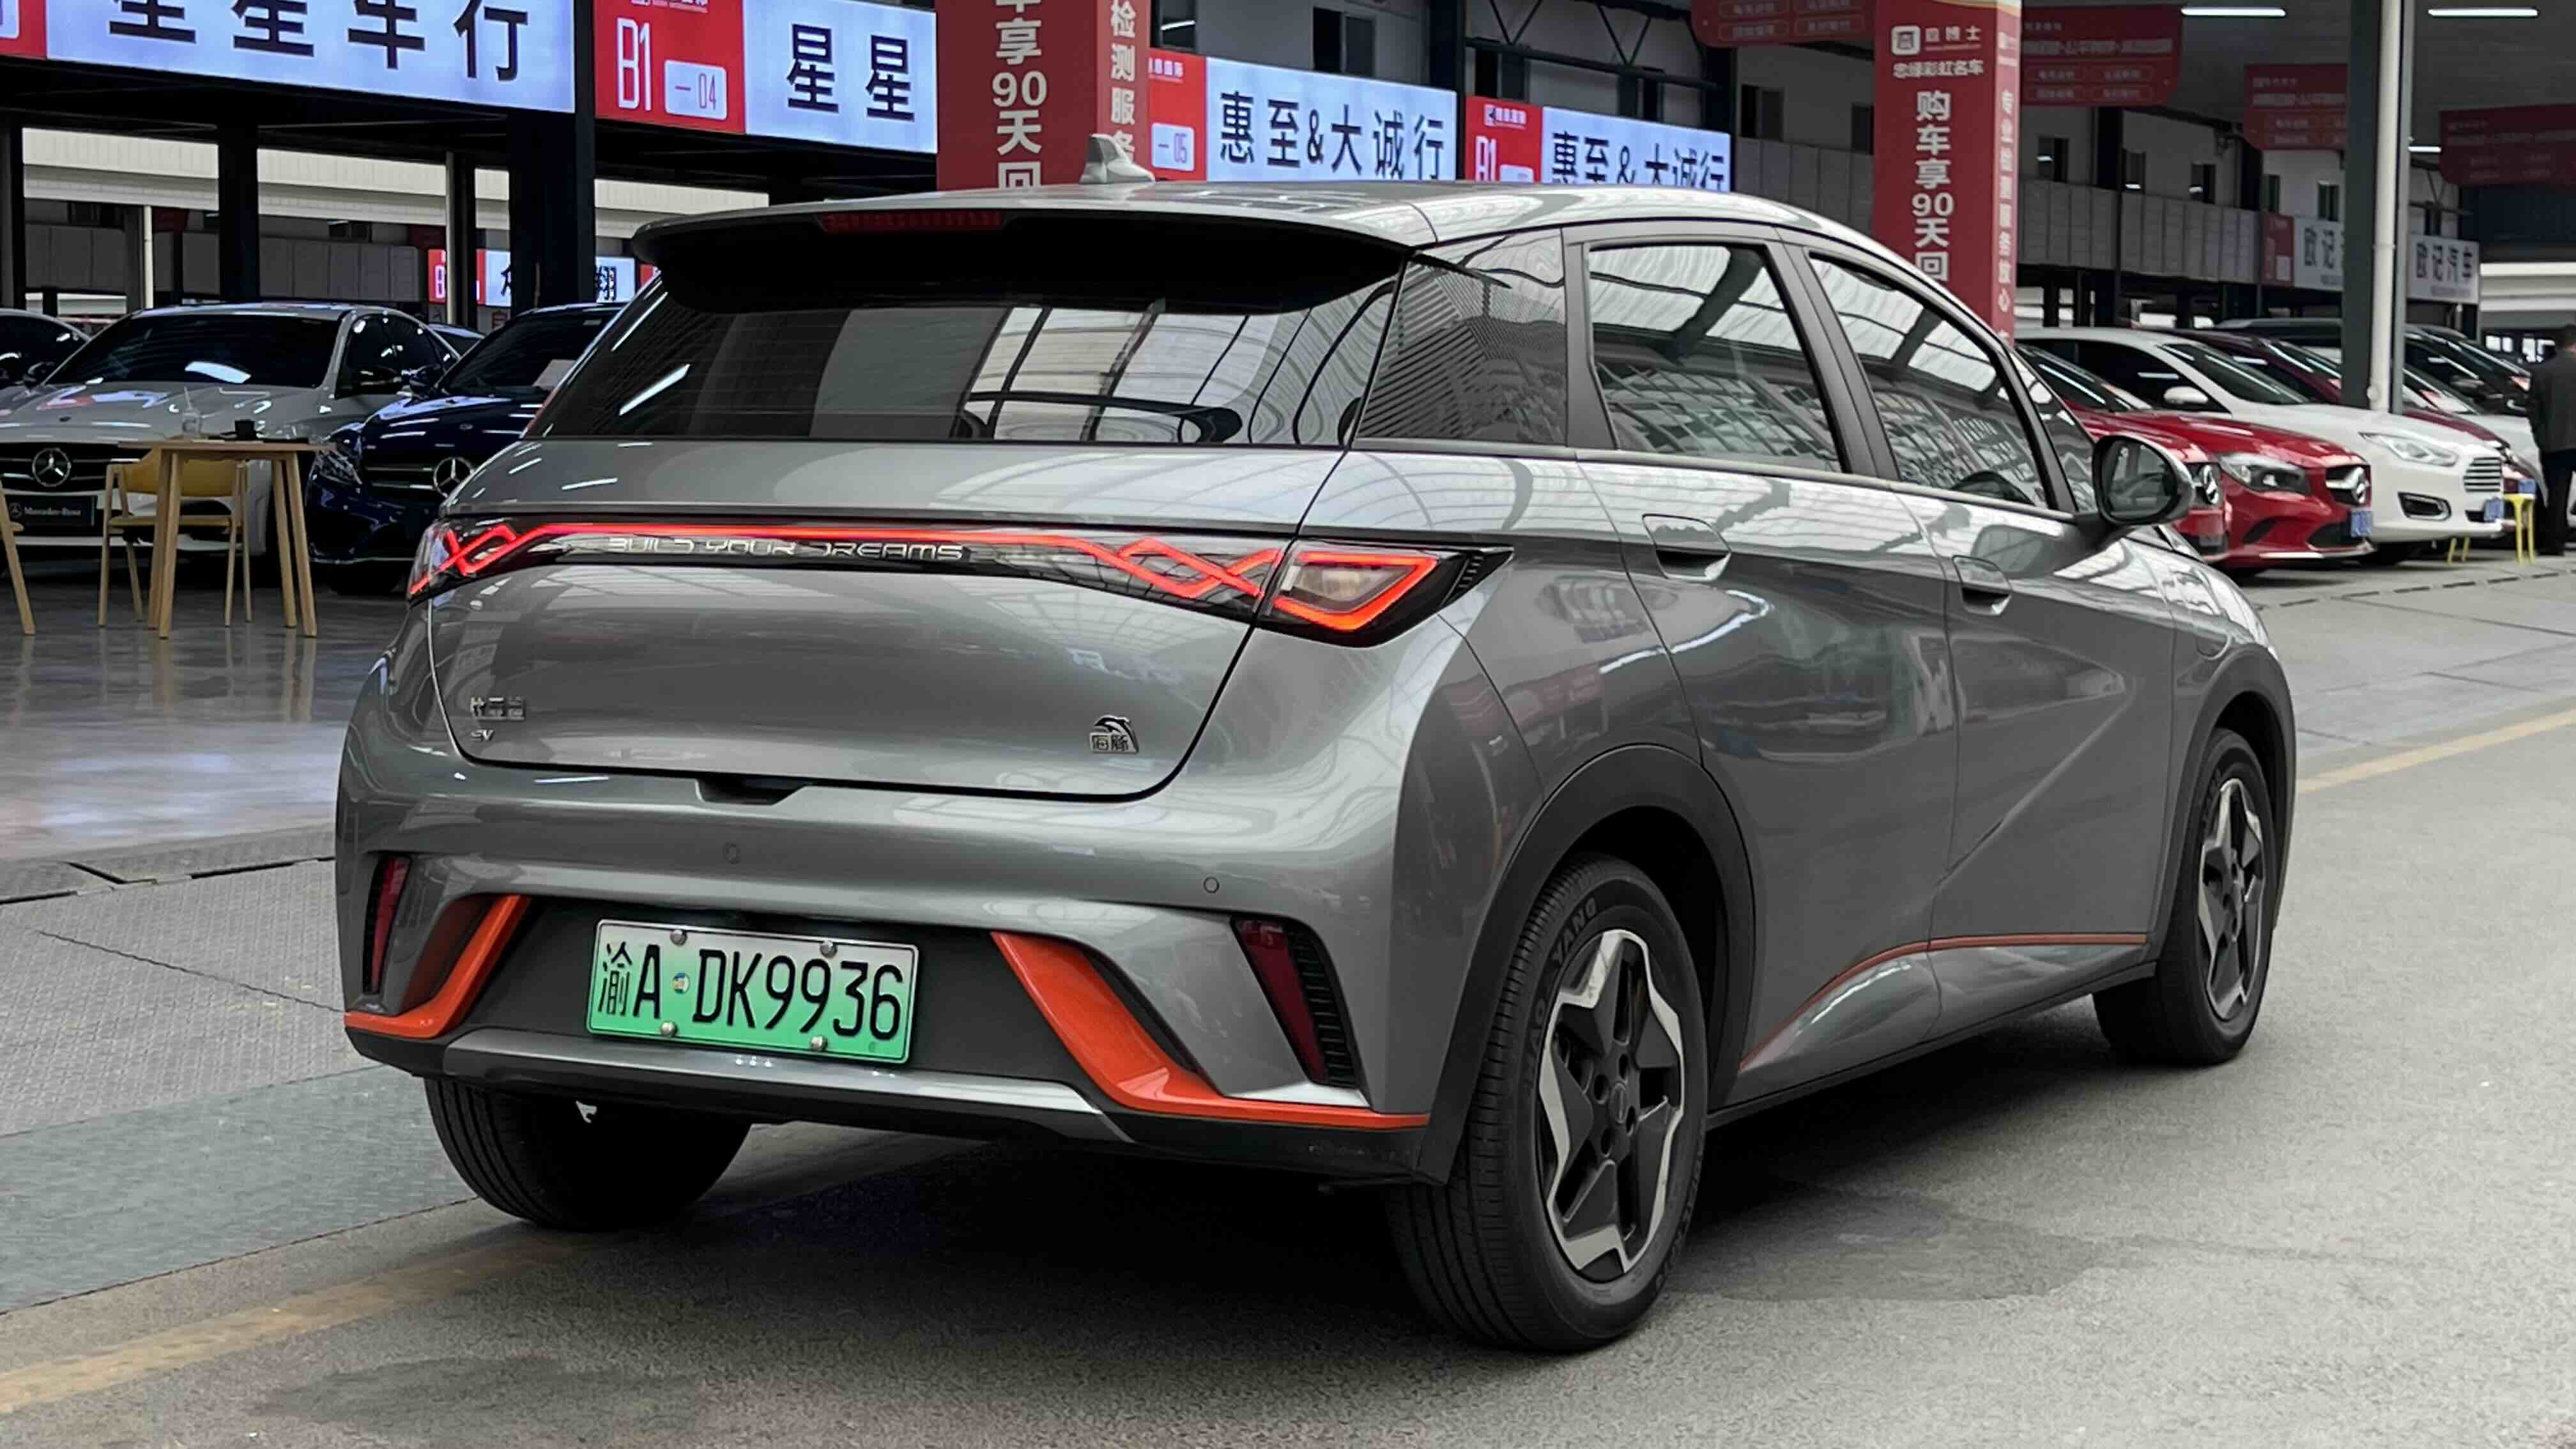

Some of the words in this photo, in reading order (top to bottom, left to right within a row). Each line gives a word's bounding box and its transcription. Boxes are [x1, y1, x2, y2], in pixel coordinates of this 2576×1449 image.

[617, 17, 652, 111] B1
[787, 24, 915, 123] 星星
[992, 0, 1048, 188] 享90天回
[705, 539, 798, 556] YOUR
[809, 542, 963, 560] DREAMS
[693, 948, 904, 1041] DK9936
